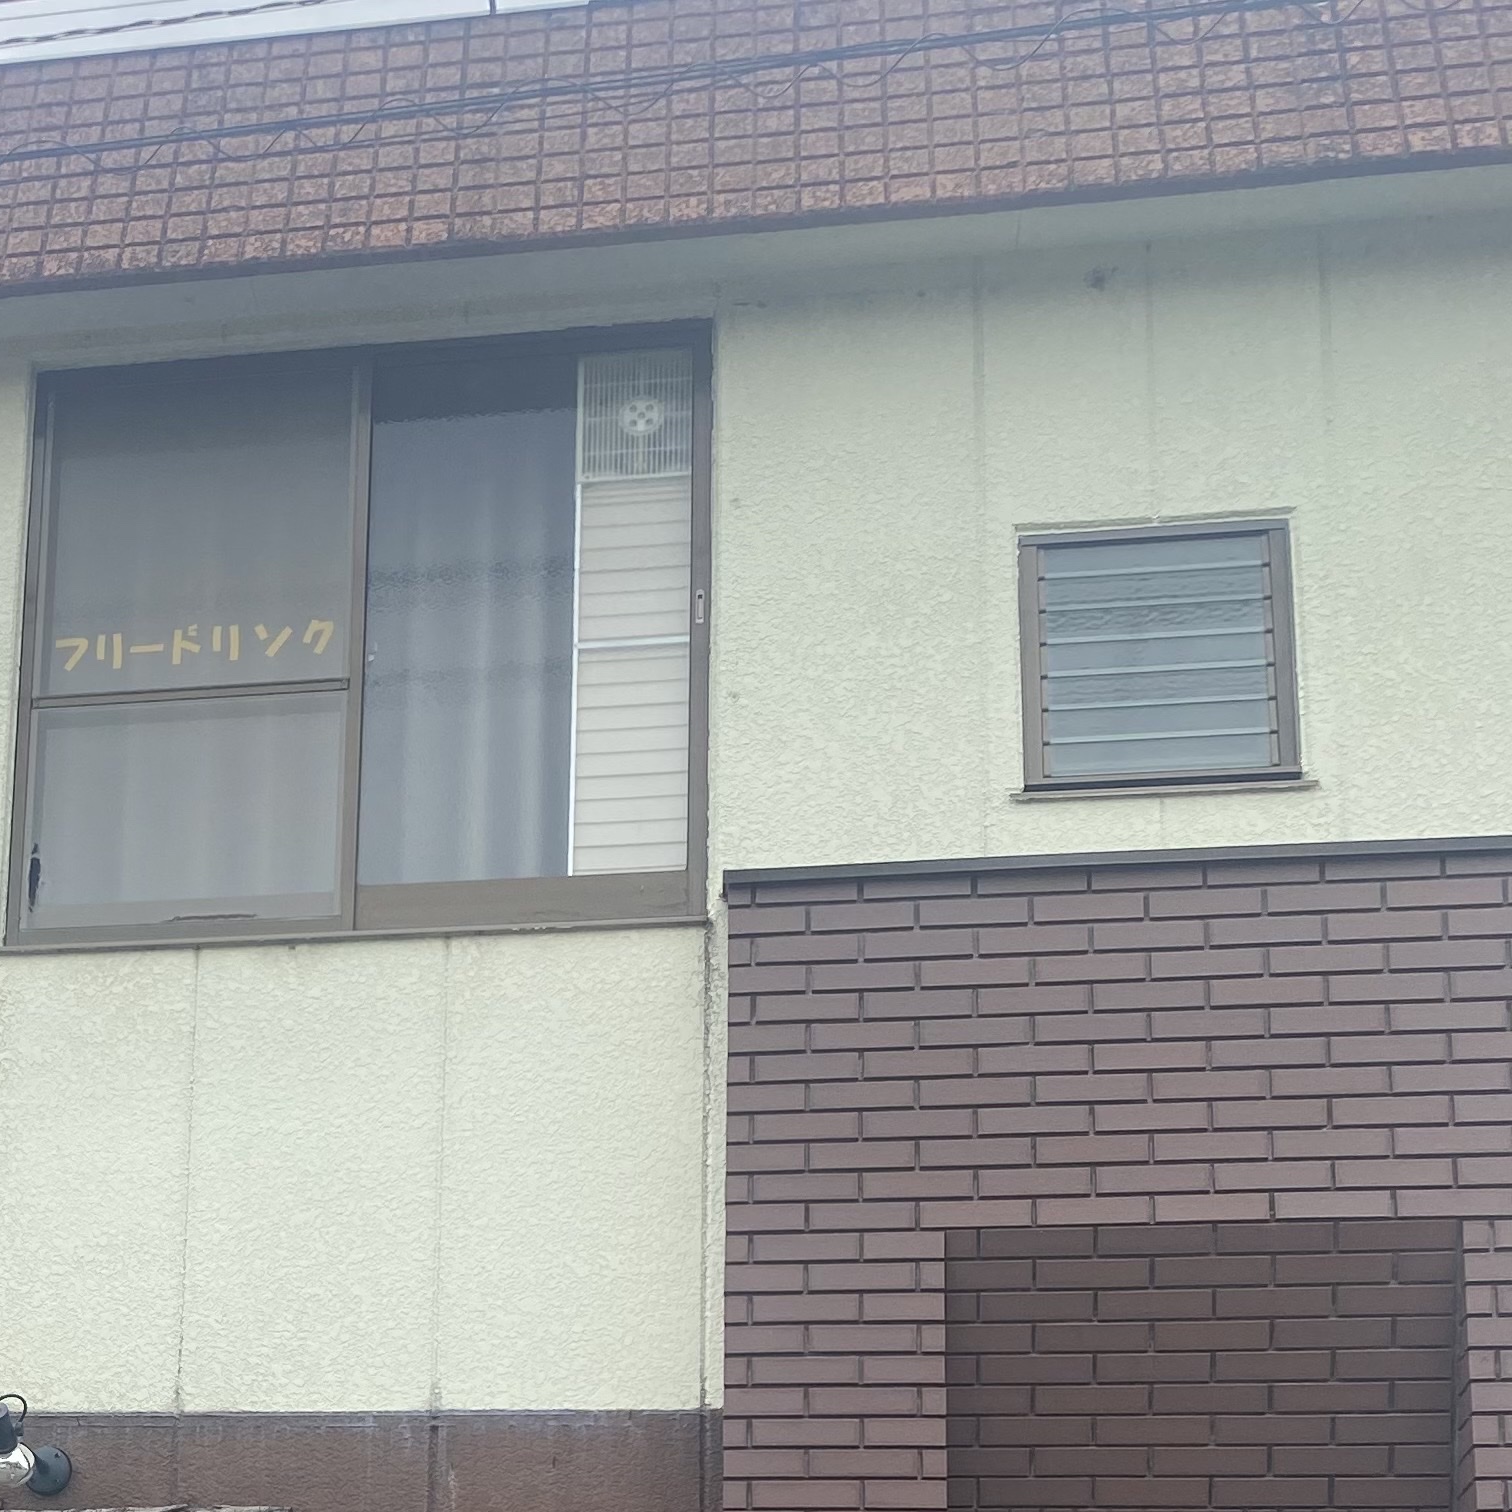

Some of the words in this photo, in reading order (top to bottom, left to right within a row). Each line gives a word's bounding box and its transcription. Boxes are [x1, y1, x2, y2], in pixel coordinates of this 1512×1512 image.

[55, 619, 335, 671] フリードリンク
